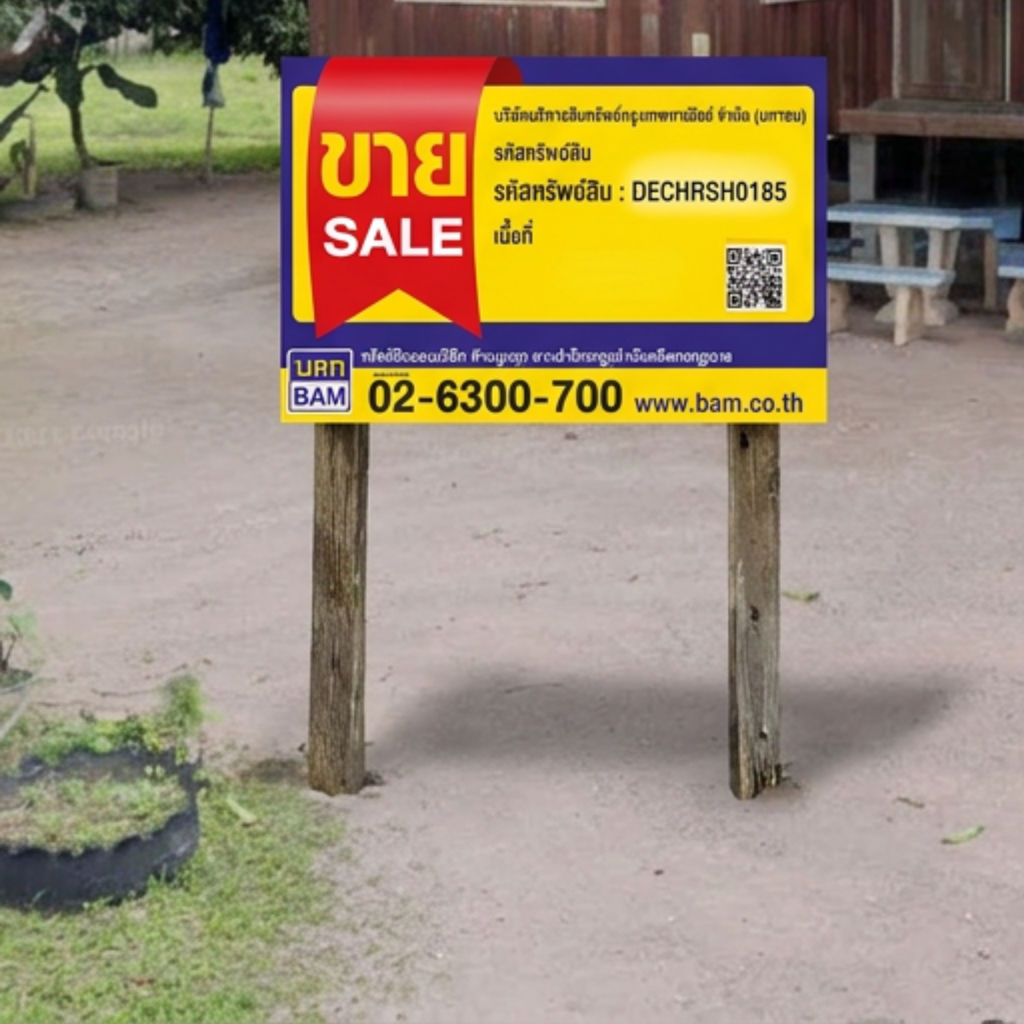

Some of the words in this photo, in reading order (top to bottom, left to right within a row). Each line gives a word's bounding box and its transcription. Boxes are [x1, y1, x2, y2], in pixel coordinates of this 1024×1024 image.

[321, 131, 467, 198] ขาย
[631, 180, 787, 203] DECHRSH0185
[323, 216, 463, 257] SALE
[293, 386, 346, 407] BAM
[368, 379, 623, 414] 02-6300-700
[634, 391, 803, 414] www.bam.co.th
